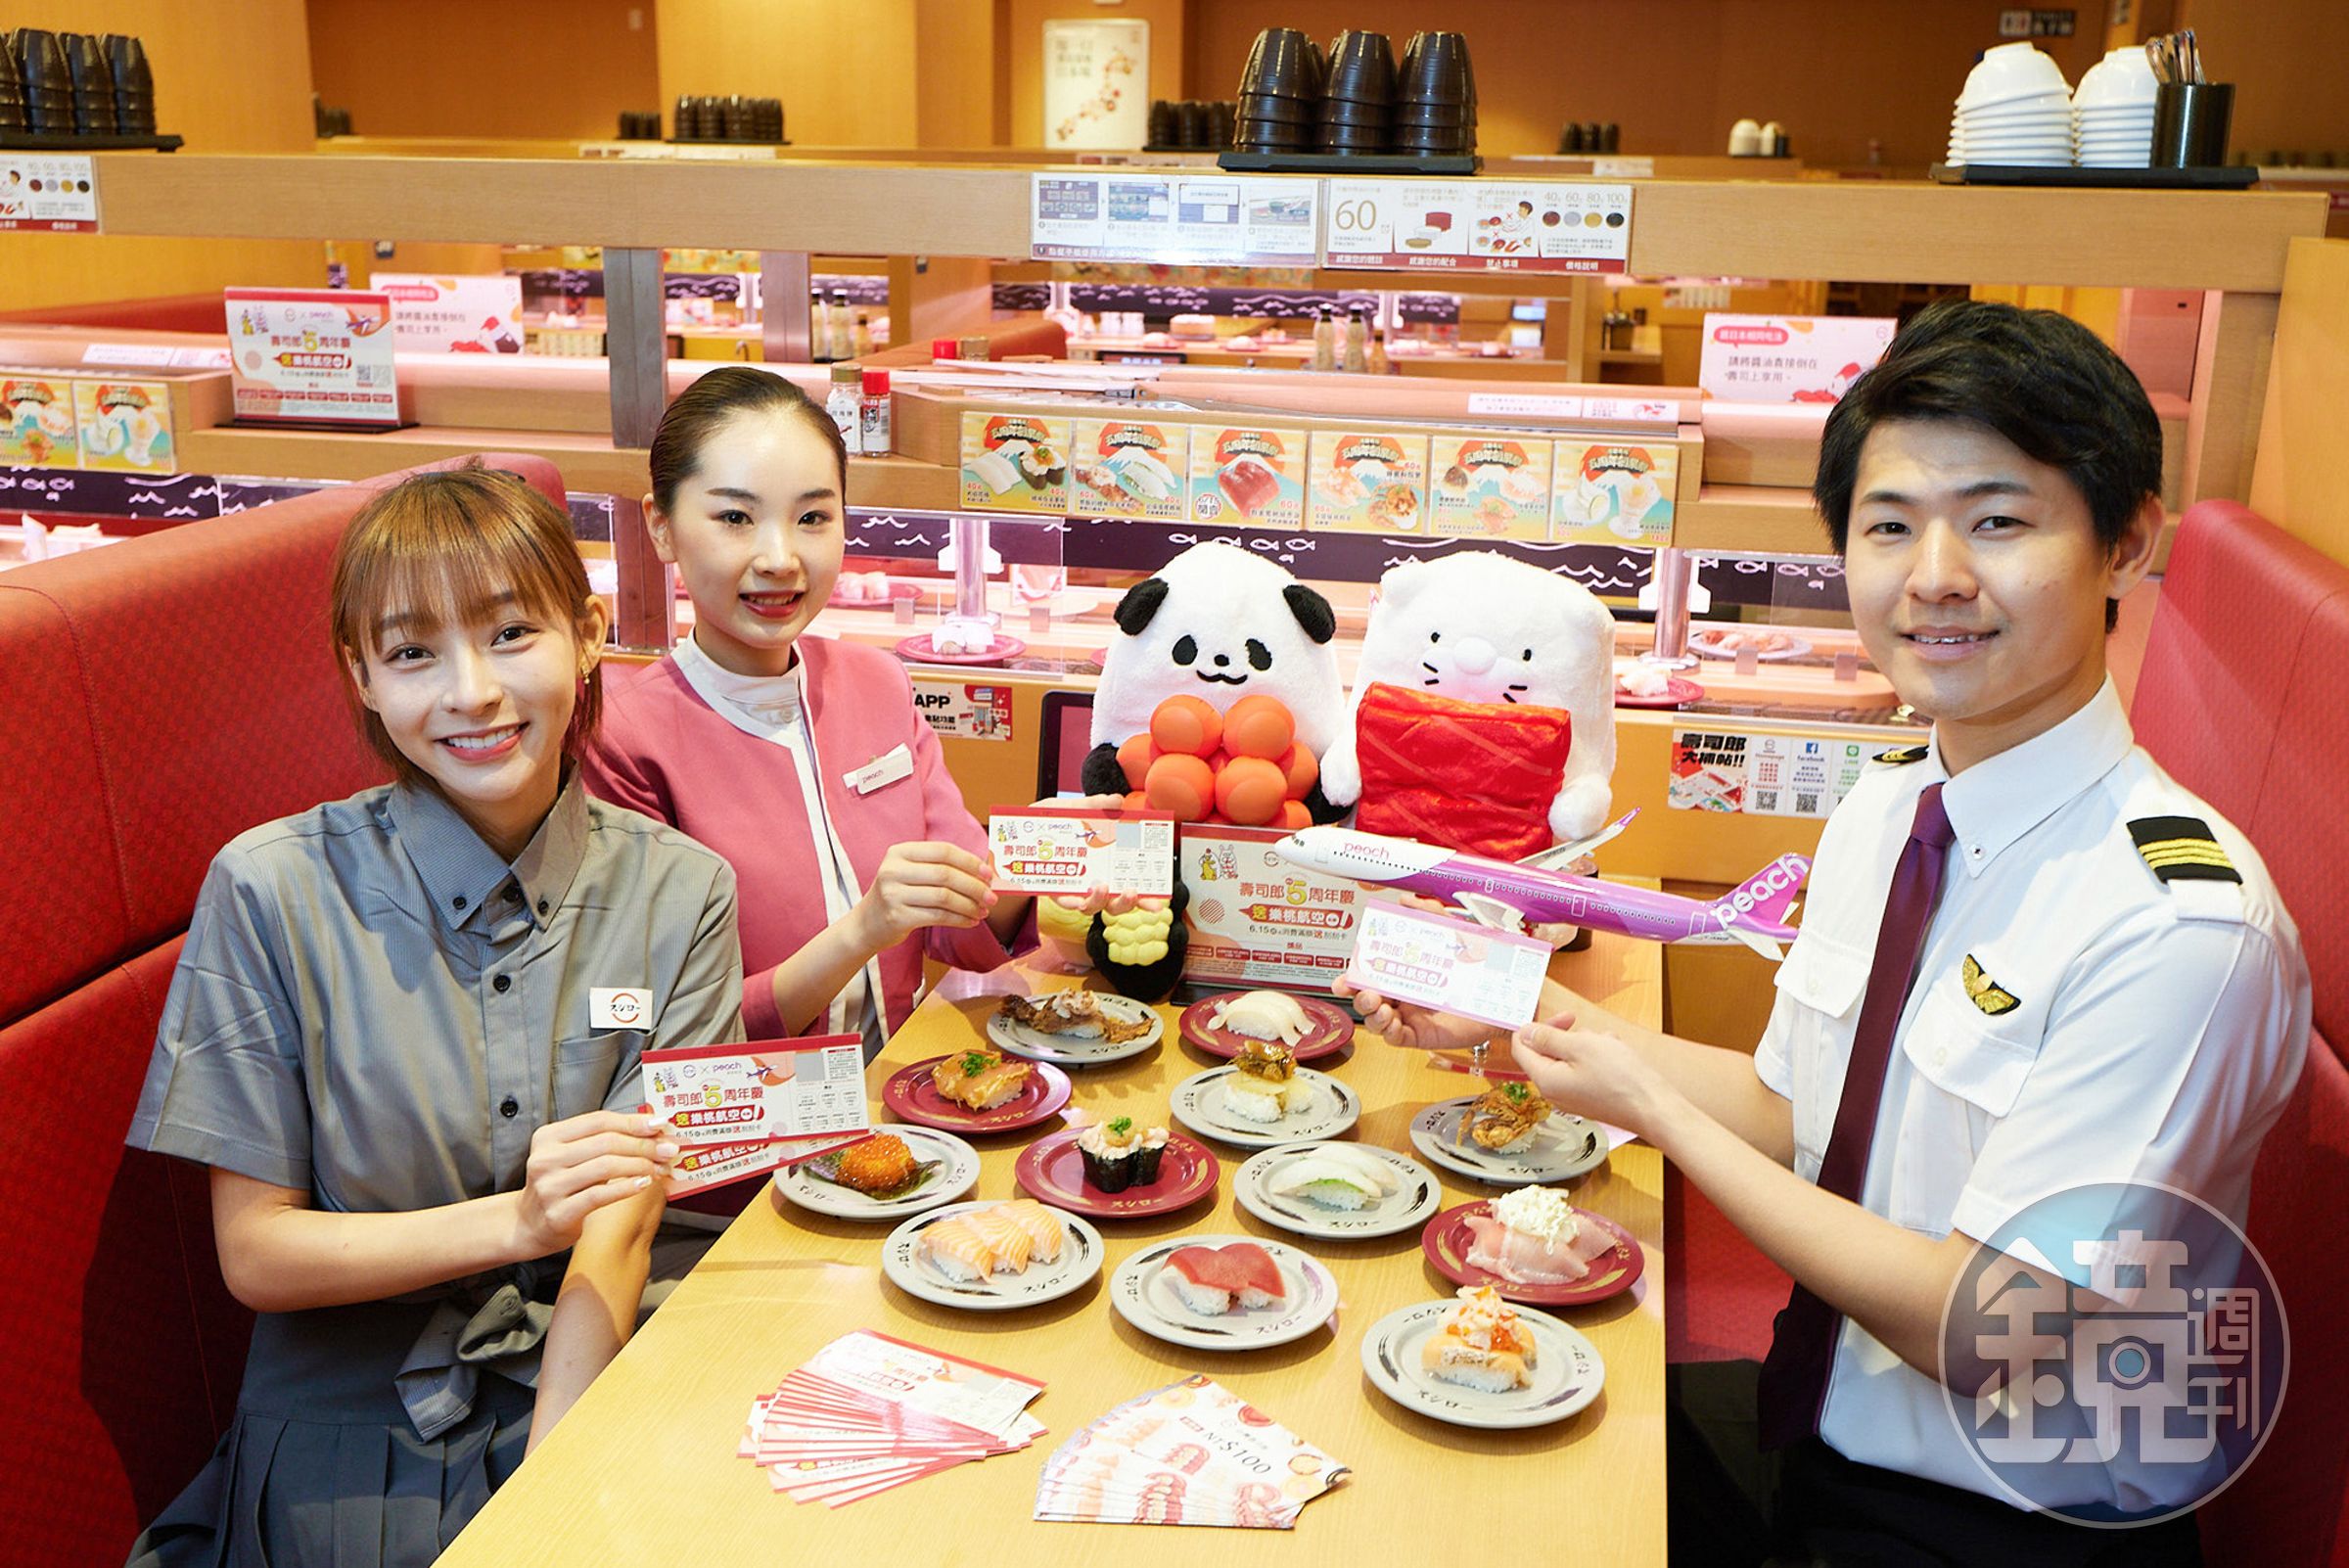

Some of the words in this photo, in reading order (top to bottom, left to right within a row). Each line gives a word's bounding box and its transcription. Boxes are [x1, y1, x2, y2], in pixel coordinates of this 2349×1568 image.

[1335, 200, 1376, 231] 60
[914, 694, 950, 709] APP
[1681, 733, 1747, 751] 壽司郎
[1344, 843, 1390, 860] peach
[1239, 878, 1356, 905] 壽司郎5周年慶
[1710, 857, 1810, 930] peach
[713, 1062, 742, 1073] peach
[1203, 1432, 1272, 1474] NT$100
